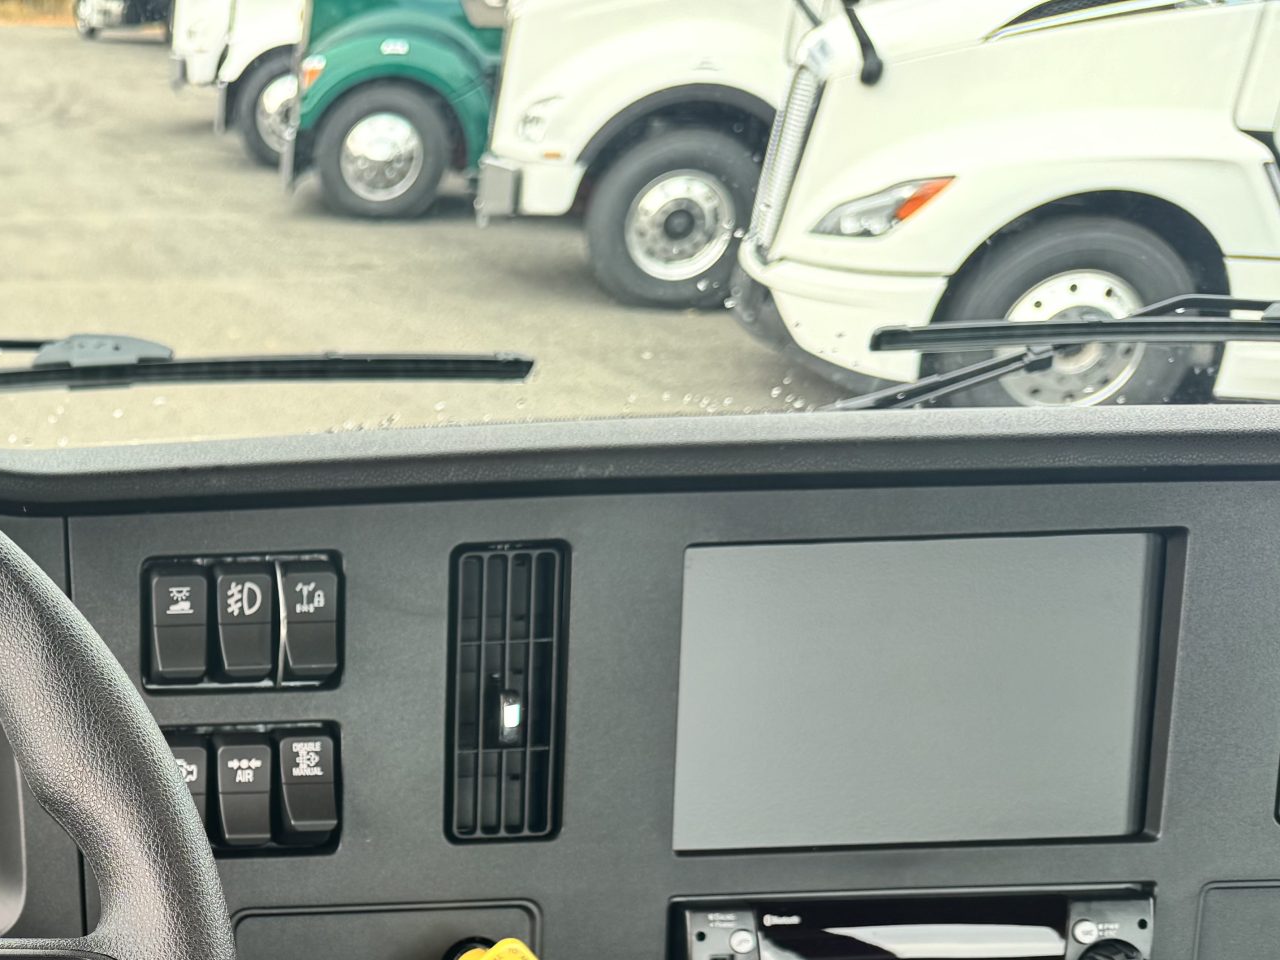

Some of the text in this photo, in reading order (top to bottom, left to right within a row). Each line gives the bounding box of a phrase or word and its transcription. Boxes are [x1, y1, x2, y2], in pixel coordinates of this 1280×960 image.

[292, 741, 321, 752] DISABLE
[235, 770, 254, 783] AIR
[292, 767, 324, 776] MANUAL
